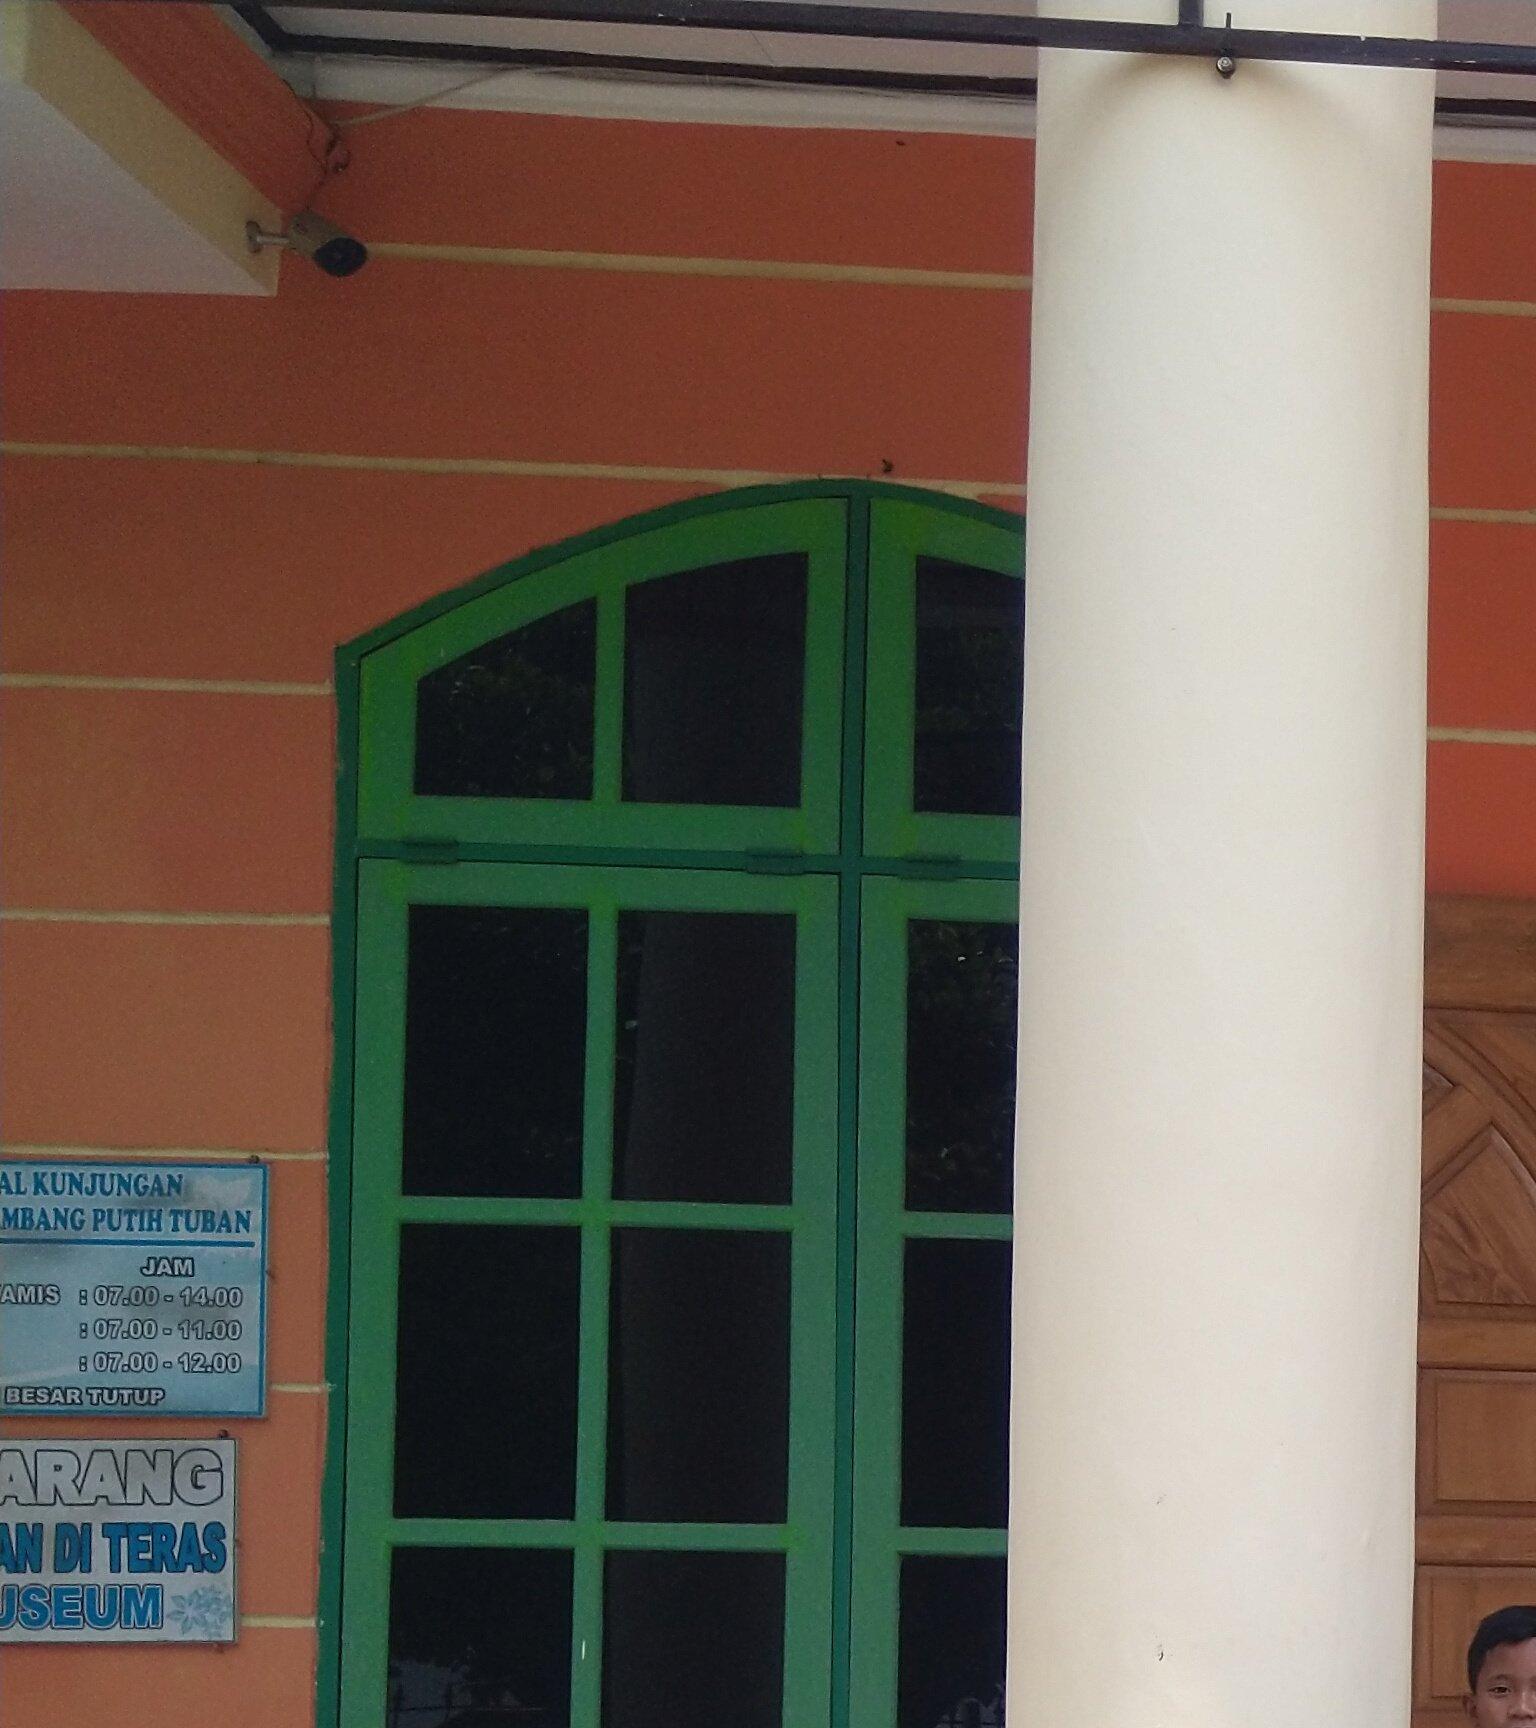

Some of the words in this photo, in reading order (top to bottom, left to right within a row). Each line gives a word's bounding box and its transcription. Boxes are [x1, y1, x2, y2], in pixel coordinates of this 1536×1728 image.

[33, 1172, 183, 1197] KUNJUNGAN
[92, 1208, 163, 1233] PUTIH
[169, 1209, 251, 1233] TUBAN
[140, 1257, 195, 1277] JAM
[94, 1286, 159, 1306] 07.00
[180, 1287, 243, 1307] 14.00
[94, 1319, 158, 1339] 07.00
[178, 1319, 242, 1340] 11.00
[94, 1352, 158, 1372] 07.00
[178, 1353, 242, 1373] 12.00
[5, 1386, 83, 1405] BESAR
[85, 1387, 166, 1406] TUTUP
[0, 1449, 224, 1506] ARANG
[54, 1522, 91, 1573] DI
[102, 1521, 226, 1573] TERAS
